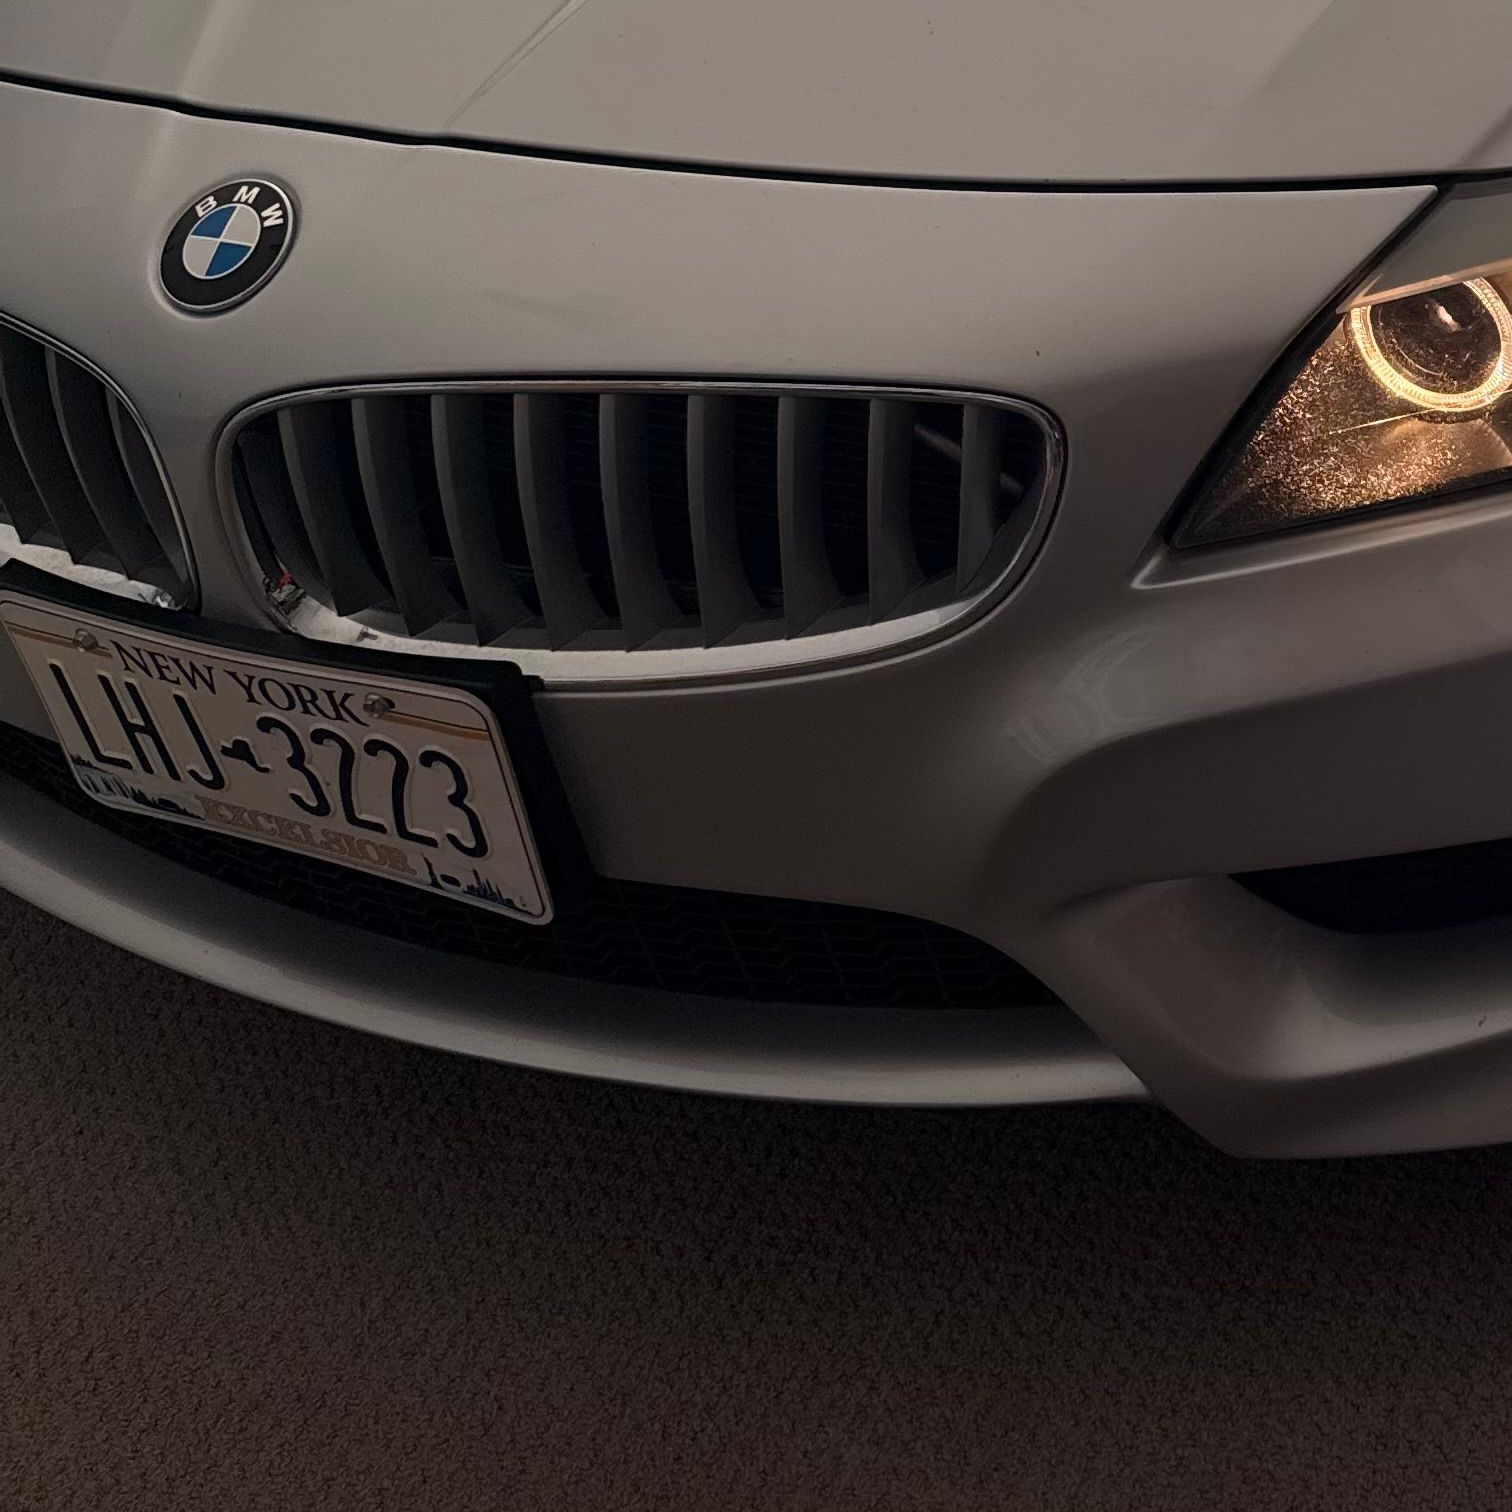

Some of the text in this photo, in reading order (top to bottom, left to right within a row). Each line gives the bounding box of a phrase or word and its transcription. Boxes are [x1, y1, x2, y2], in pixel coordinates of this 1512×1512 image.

[194, 185, 284, 228] BMW
[109, 640, 372, 726] NEW YORK
[197, 796, 417, 875] EXCELSIOR
